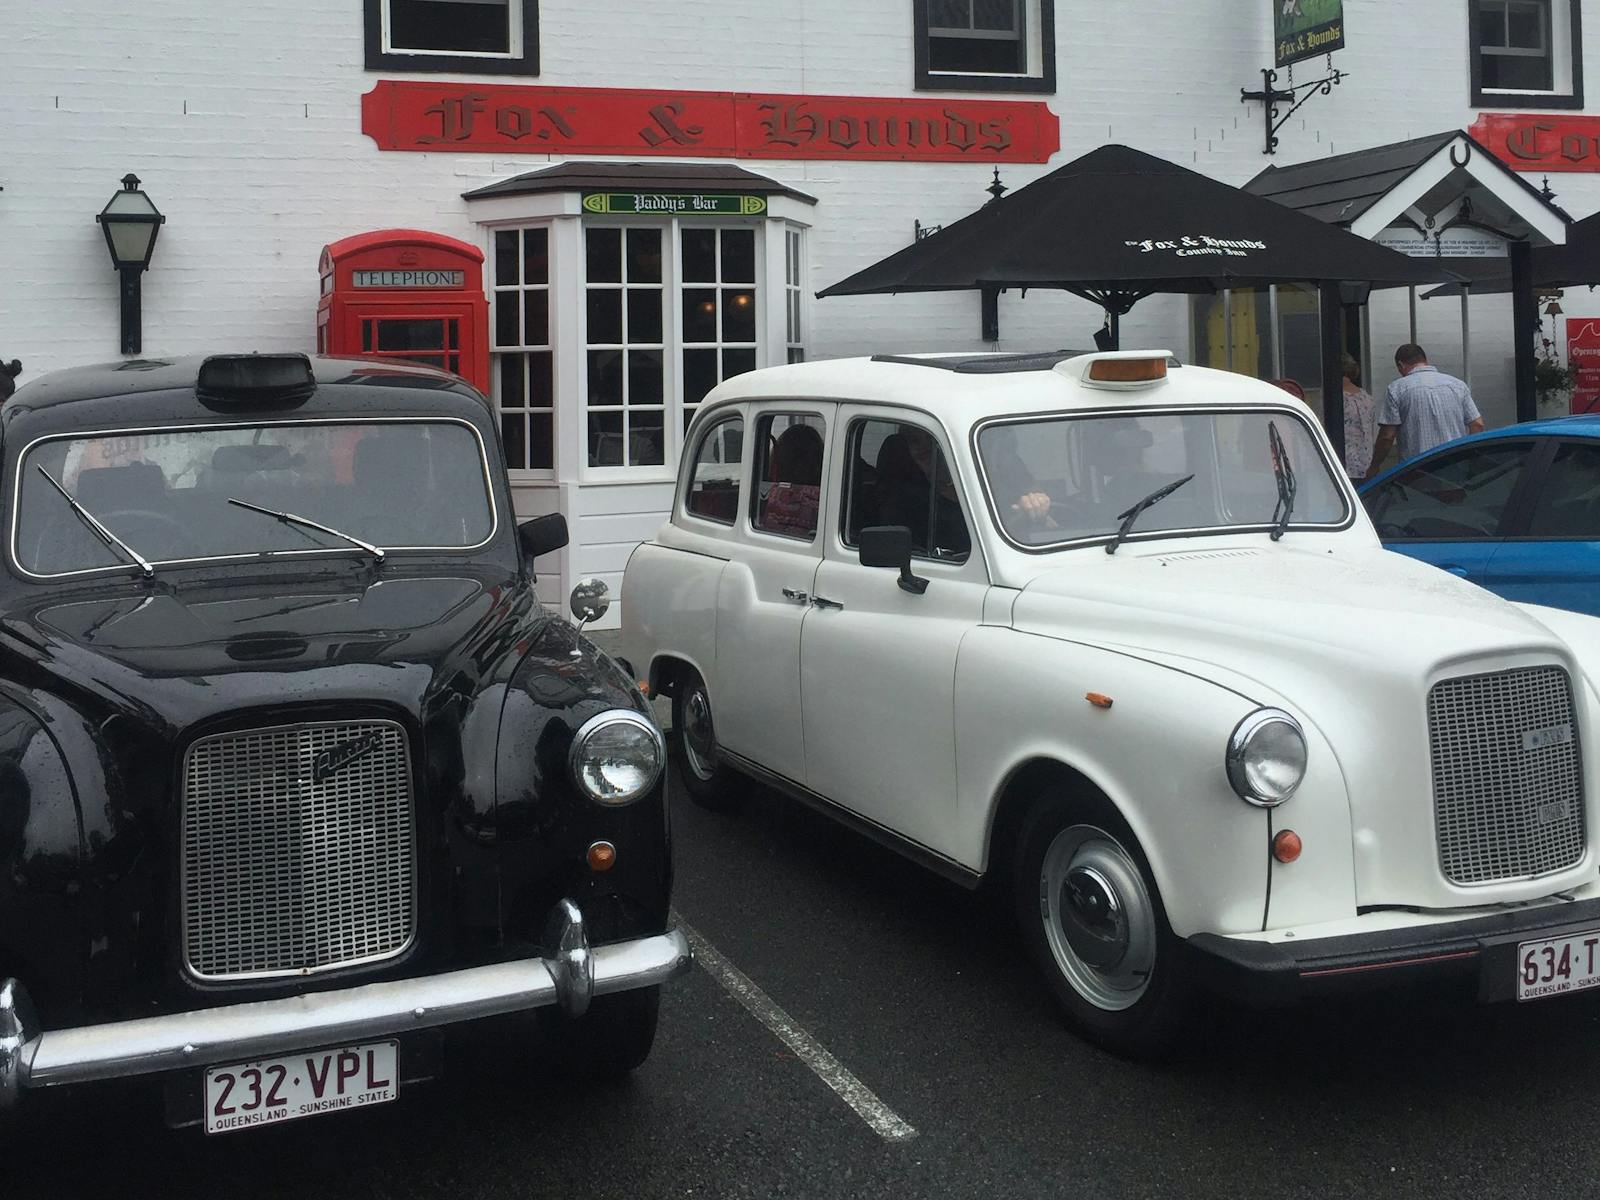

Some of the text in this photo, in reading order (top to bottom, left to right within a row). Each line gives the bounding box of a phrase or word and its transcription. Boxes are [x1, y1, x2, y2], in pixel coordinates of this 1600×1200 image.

[1297, 35, 1306, 51] &
[1306, 26, 1341, 48] Hounds
[416, 92, 1013, 152] Fox & Hounds
[1505, 124, 1600, 162] Co
[692, 194, 719, 210] Bar
[1138, 240, 1178, 252] Fox
[1180, 236, 1199, 247] &
[1199, 235, 1267, 249] Hounds
[1175, 248, 1248, 257] Country Inn
[356, 271, 461, 285] TELEPHONE
[1524, 982, 1571, 998] QUEENSLAND
[216, 1089, 390, 1130] QUEENSLAND SUNSHINE STATE
